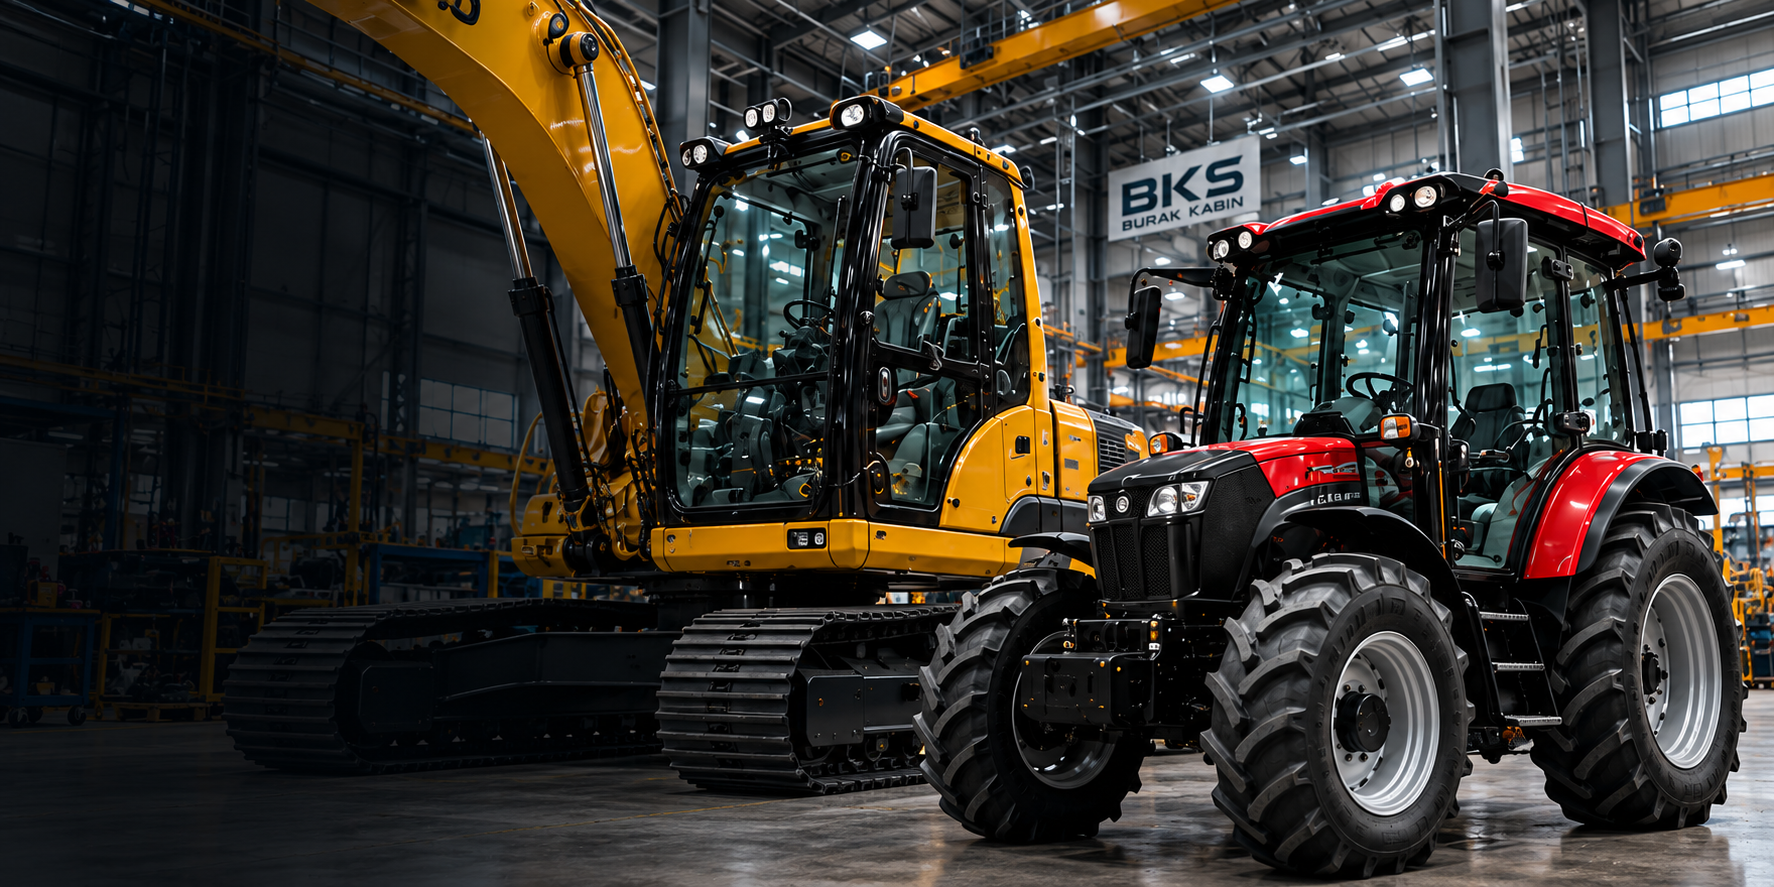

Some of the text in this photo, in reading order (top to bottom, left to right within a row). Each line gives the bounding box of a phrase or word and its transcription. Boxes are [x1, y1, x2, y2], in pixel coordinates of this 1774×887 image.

[1122, 155, 1244, 217] BKS
[1122, 196, 1243, 232] BURAK KABIN
